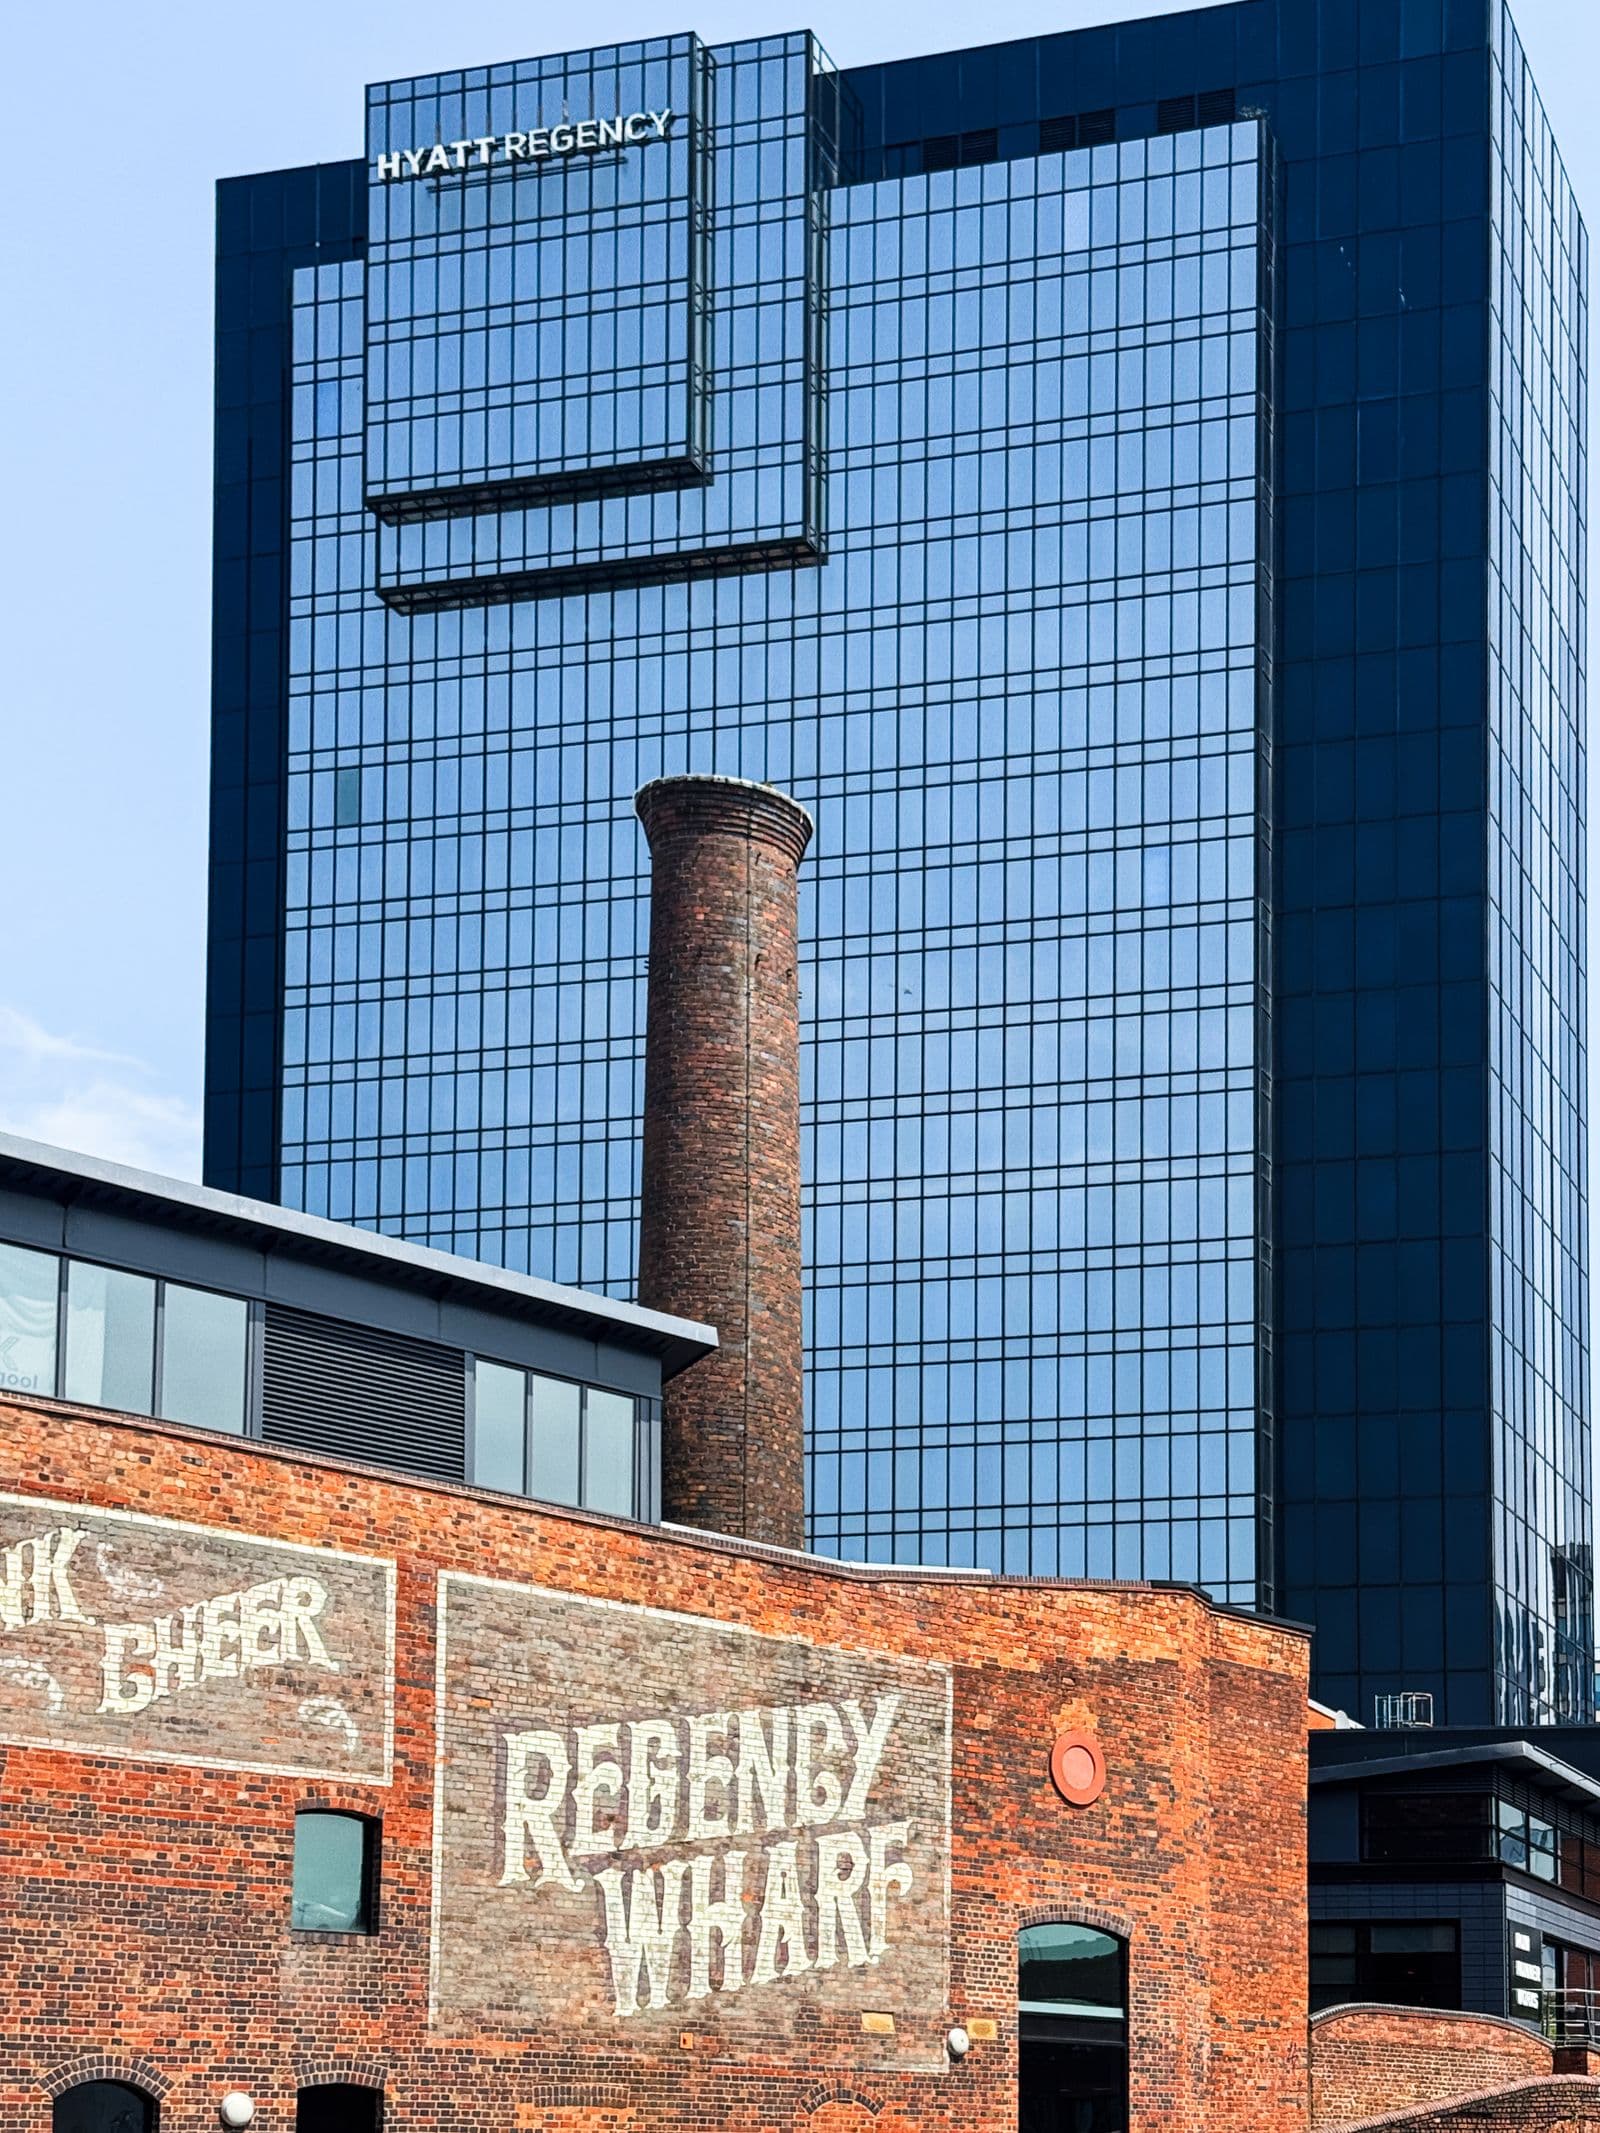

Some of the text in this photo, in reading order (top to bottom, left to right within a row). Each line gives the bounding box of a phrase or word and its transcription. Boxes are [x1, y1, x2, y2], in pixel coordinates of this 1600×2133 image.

[377, 108, 672, 180] HYATT REGENCY
[499, 1693, 903, 1893] REGENCY
[593, 1818, 914, 2017] WHARF
